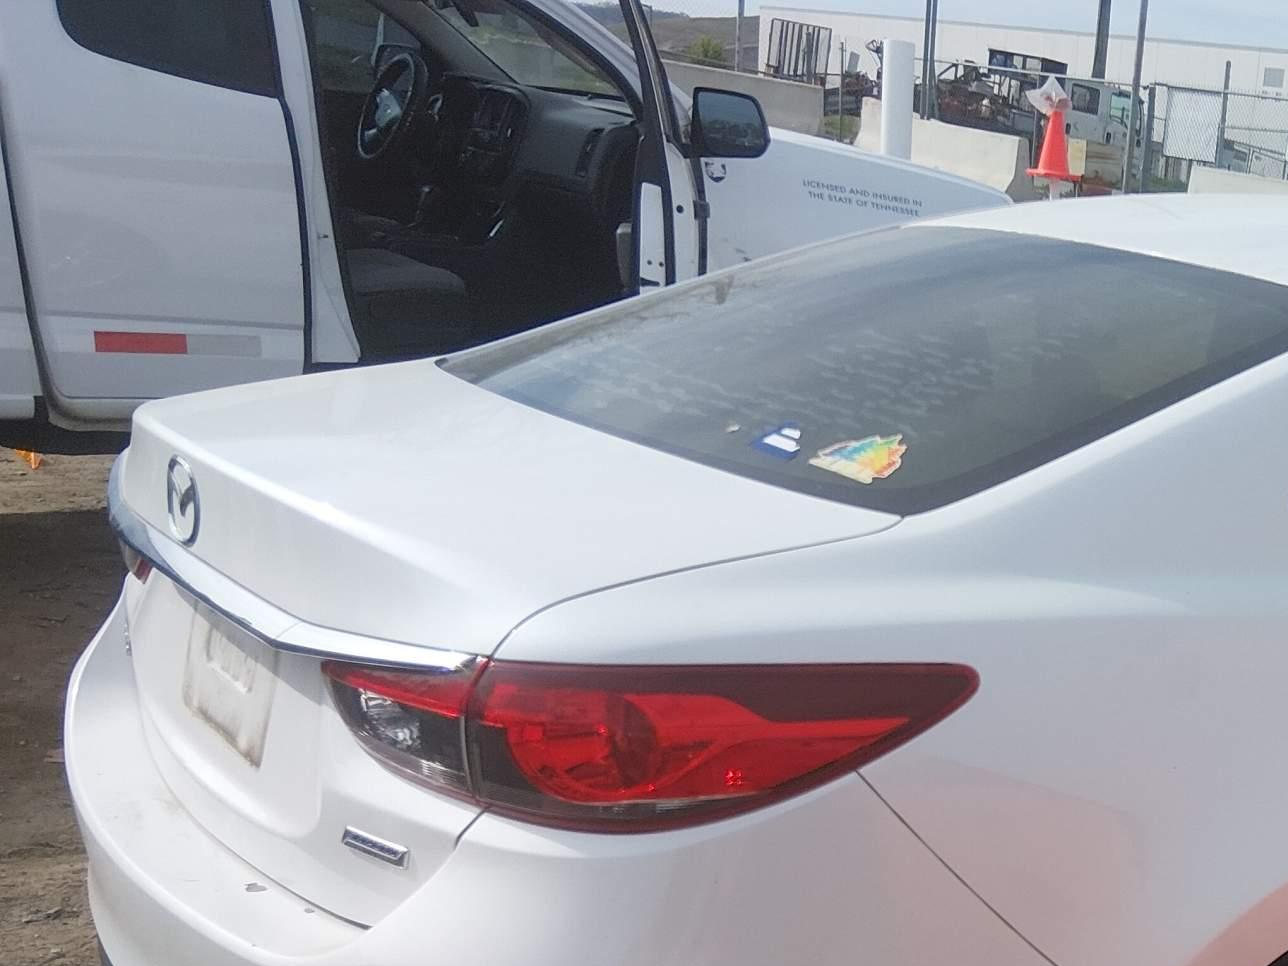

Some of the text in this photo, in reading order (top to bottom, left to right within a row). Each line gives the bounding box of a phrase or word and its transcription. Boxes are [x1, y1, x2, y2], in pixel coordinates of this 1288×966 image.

[802, 179, 923, 208] LICENSED AND INSURED IN
[808, 191, 921, 217] THE STATE OF TENNESSEE
